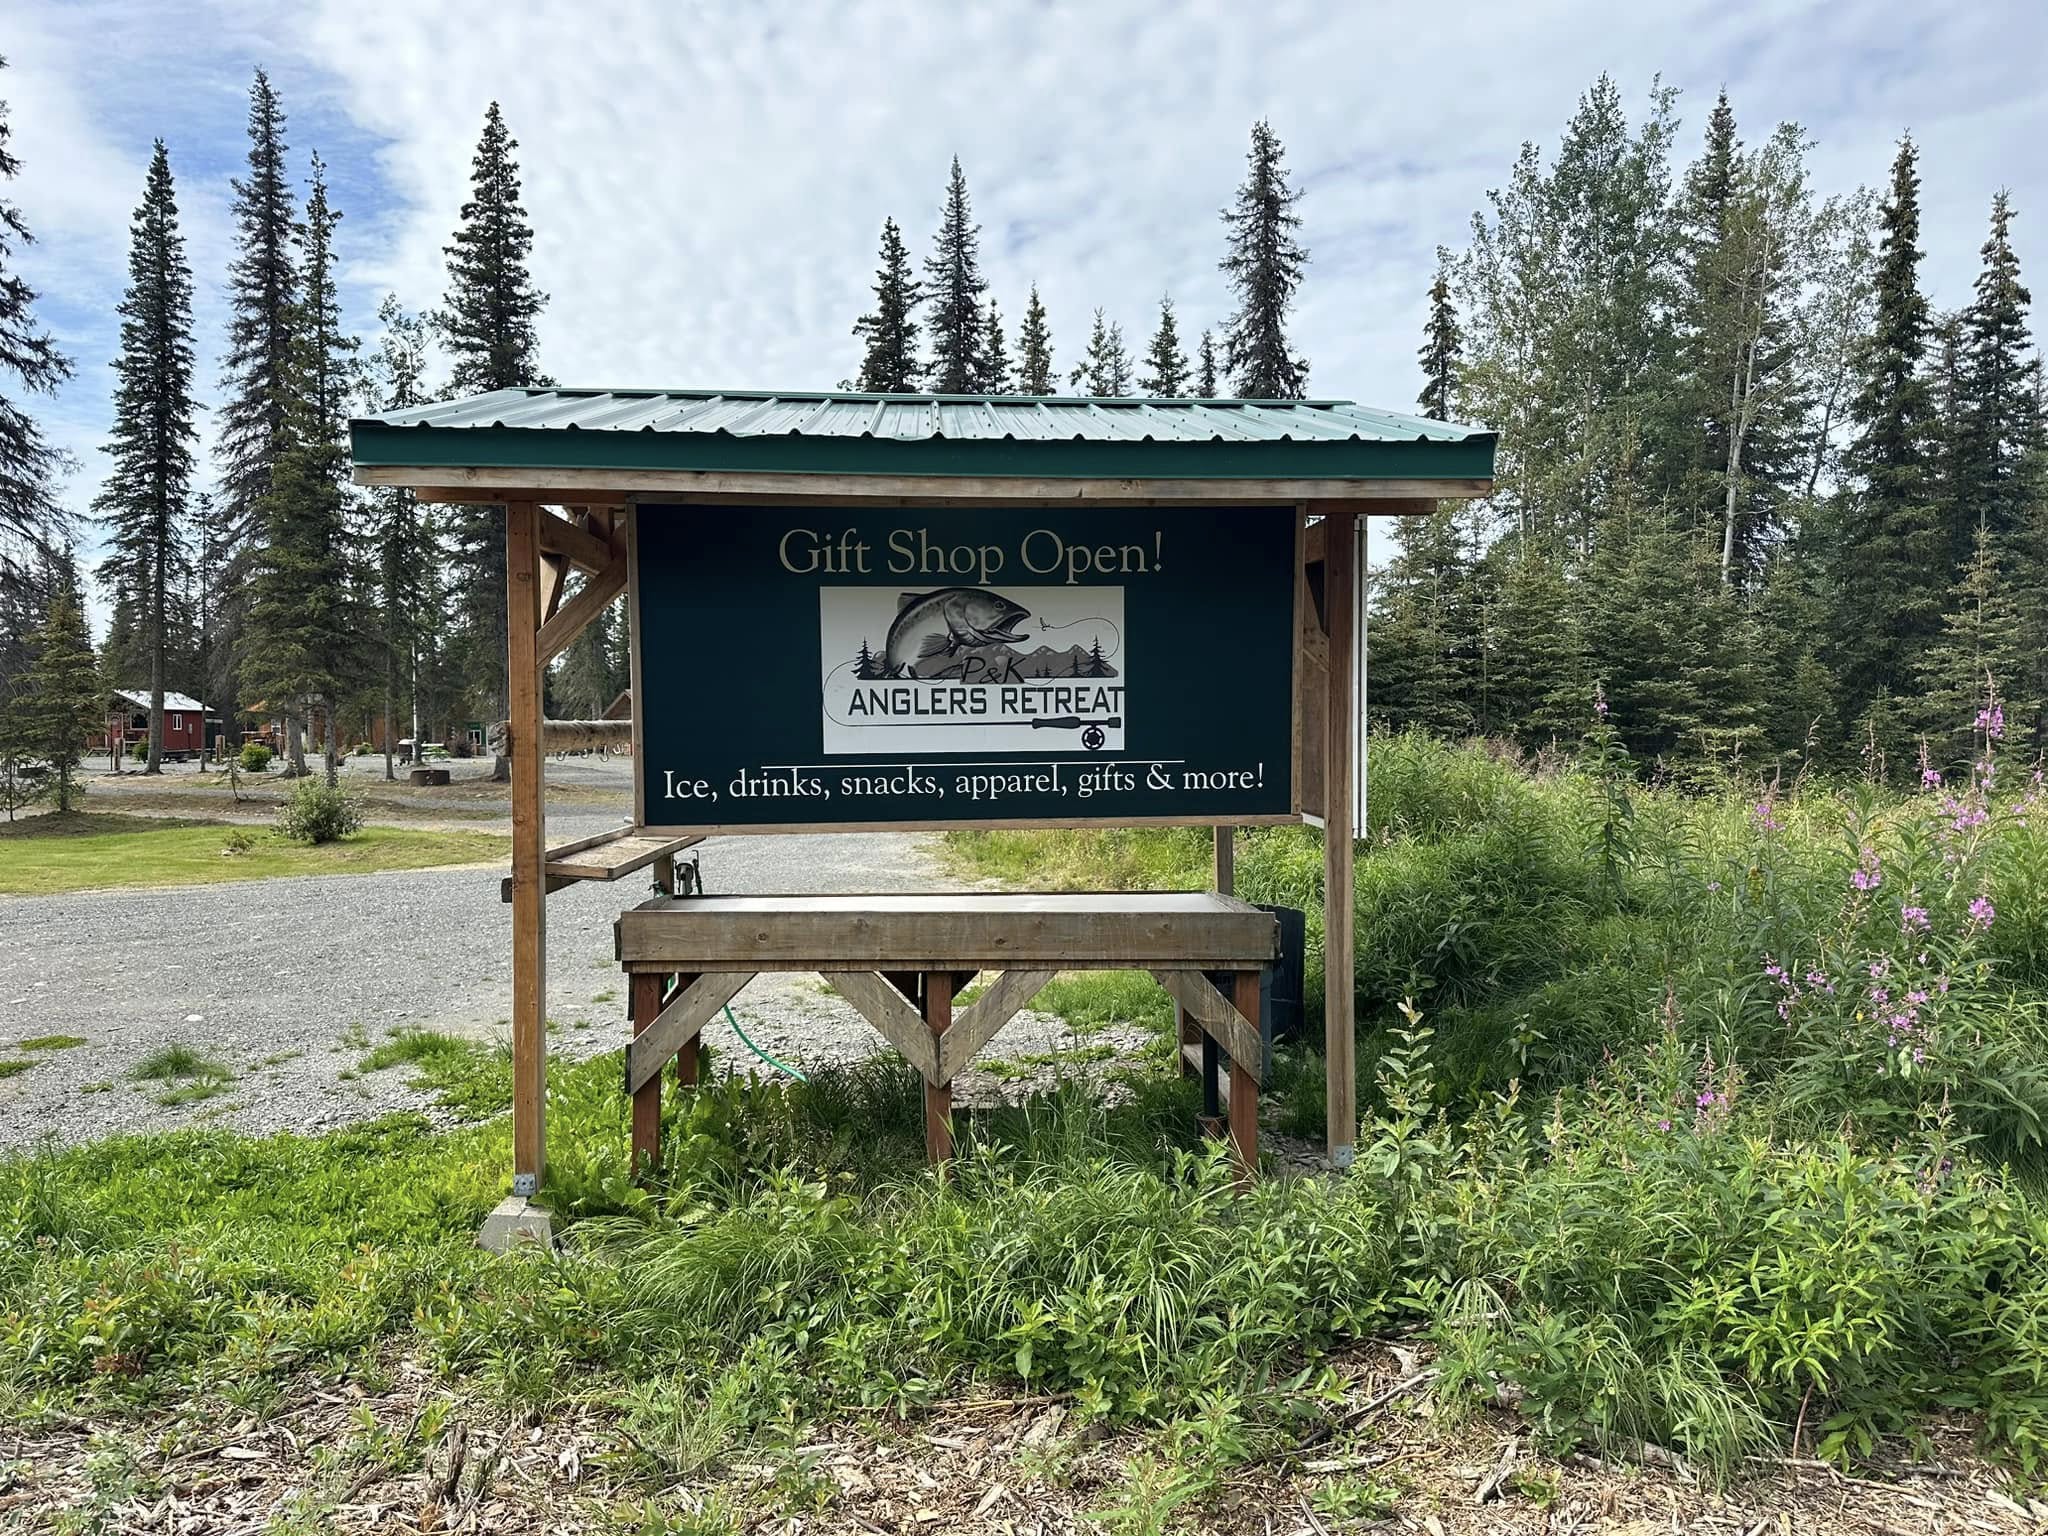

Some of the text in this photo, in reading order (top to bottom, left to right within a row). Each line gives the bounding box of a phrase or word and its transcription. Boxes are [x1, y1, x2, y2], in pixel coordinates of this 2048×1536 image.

[779, 528, 1162, 585] Gift Shop Open!
[960, 656, 1026, 684] P&K
[847, 686, 1125, 716] ANGLERS RETREAT
[663, 762, 1264, 803] Ice, drinks, snacks, apparel, gifts & more!
